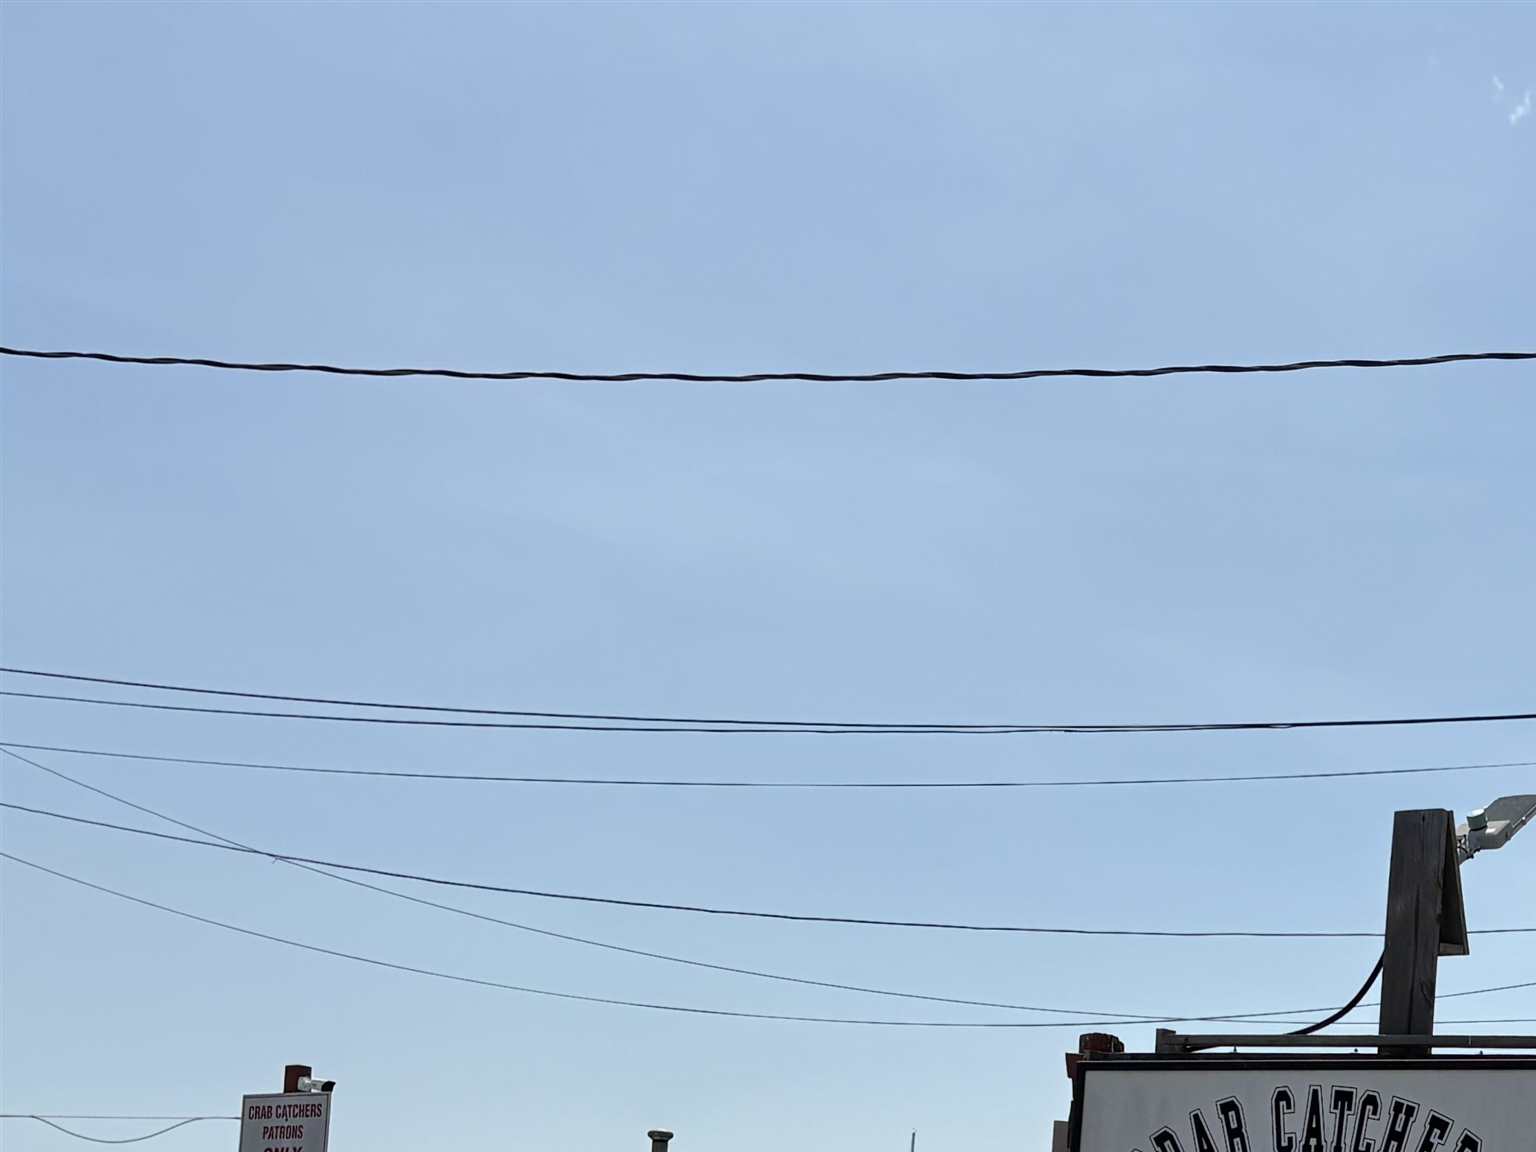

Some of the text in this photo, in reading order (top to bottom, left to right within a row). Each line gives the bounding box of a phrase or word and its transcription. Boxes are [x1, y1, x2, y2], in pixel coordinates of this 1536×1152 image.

[248, 1103, 322, 1120] CRAB CATCHERS
[262, 1125, 304, 1140] PATRONS
